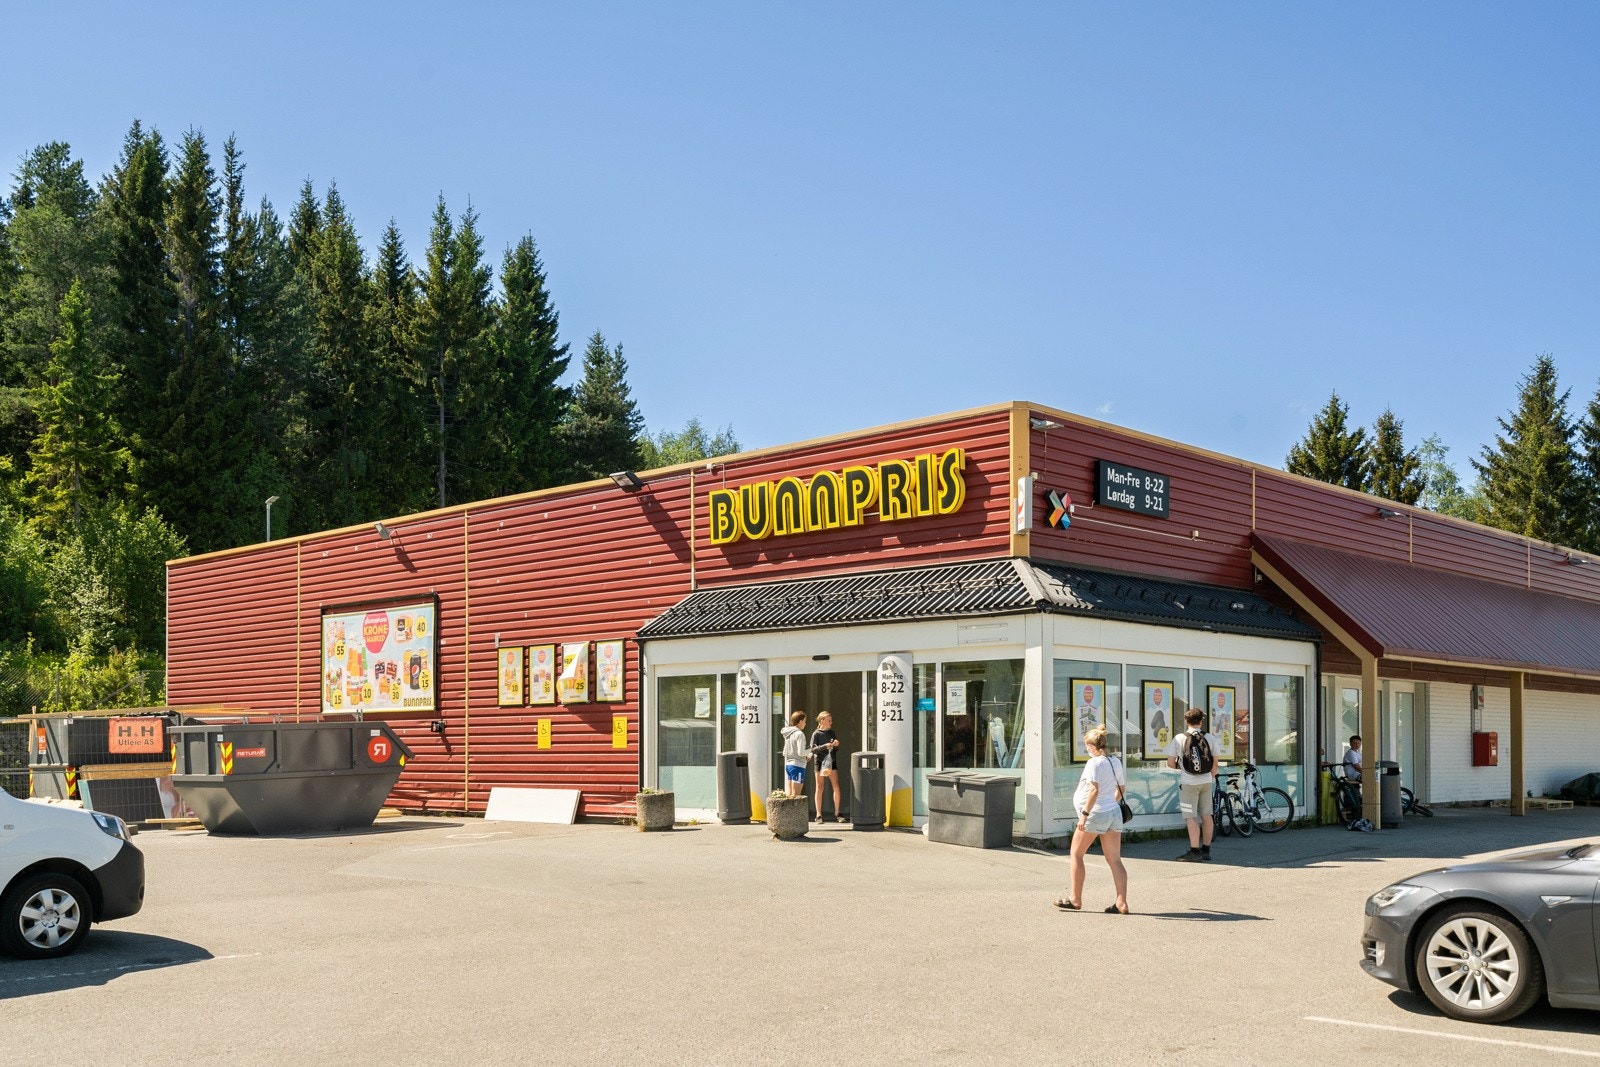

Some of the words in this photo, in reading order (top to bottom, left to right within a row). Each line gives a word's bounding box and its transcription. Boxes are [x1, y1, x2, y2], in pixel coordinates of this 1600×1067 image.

[1107, 468, 1140, 488] Man-Fre
[1145, 476, 1164, 493] 8-22
[709, 448, 966, 545] BUNNPRIS
[1107, 486, 1135, 509] Lørdag
[1145, 495, 1164, 511] 9-21
[363, 624, 388, 636] KRONE
[417, 622, 426, 632] 40
[336, 646, 344, 655] 55
[421, 680, 429, 688] 15
[881, 681, 904, 693] 8-22
[364, 689, 371, 699] 10
[740, 686, 760, 698] 8-22
[334, 695, 341, 704] 15
[883, 699, 901, 708] Lørdag
[740, 713, 760, 724] 9-21
[881, 709, 904, 722] 9-21
[118, 725, 131, 737] H
[141, 725, 154, 737] H
[143, 738, 154, 746] AS
